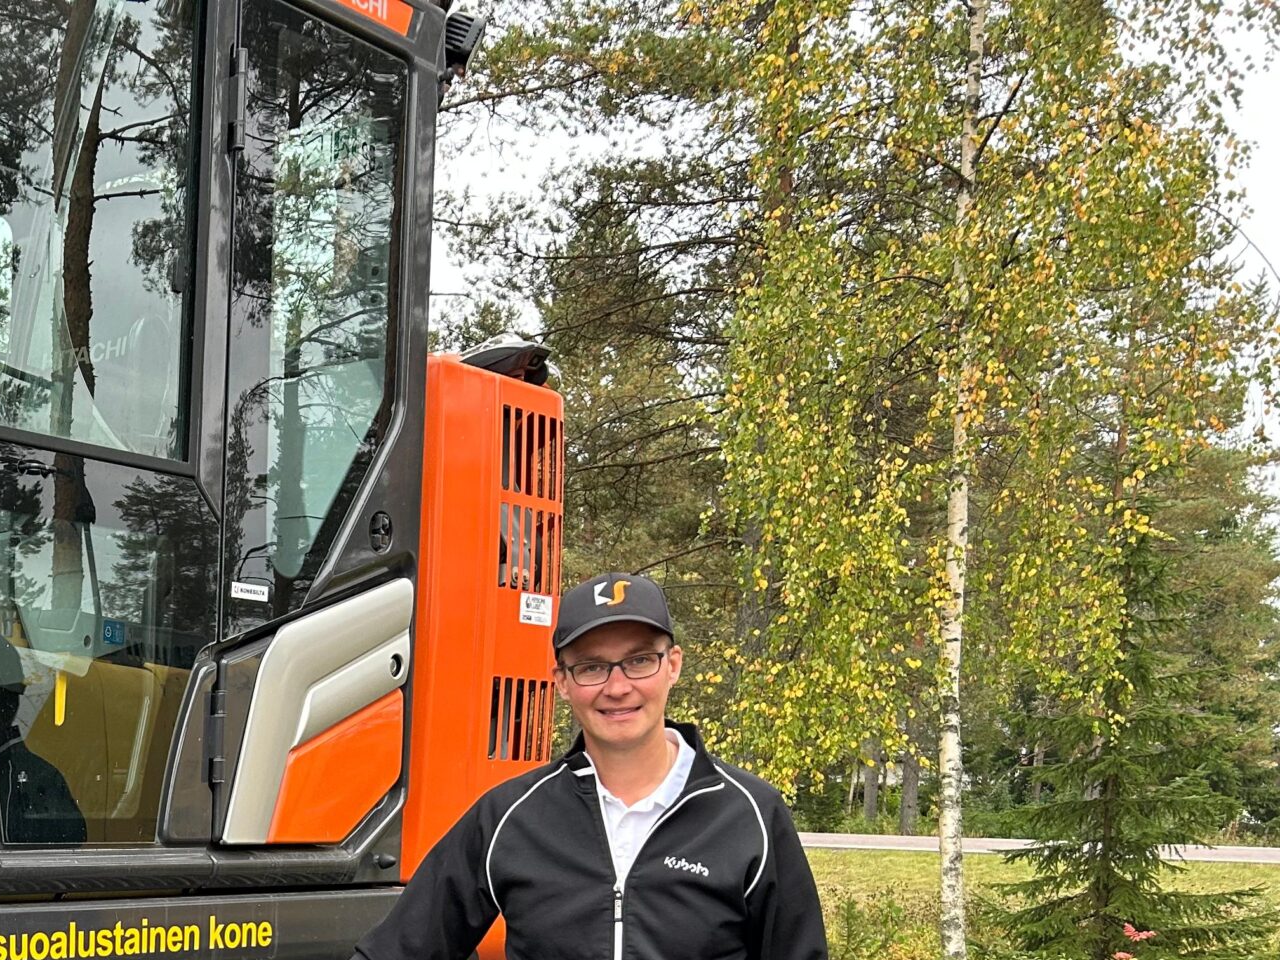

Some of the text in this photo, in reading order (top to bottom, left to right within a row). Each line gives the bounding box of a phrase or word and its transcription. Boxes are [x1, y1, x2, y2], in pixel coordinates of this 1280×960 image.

[240, 587, 265, 596] KONESILTA
[663, 856, 710, 877] Kubota
[209, 916, 273, 949] kone
